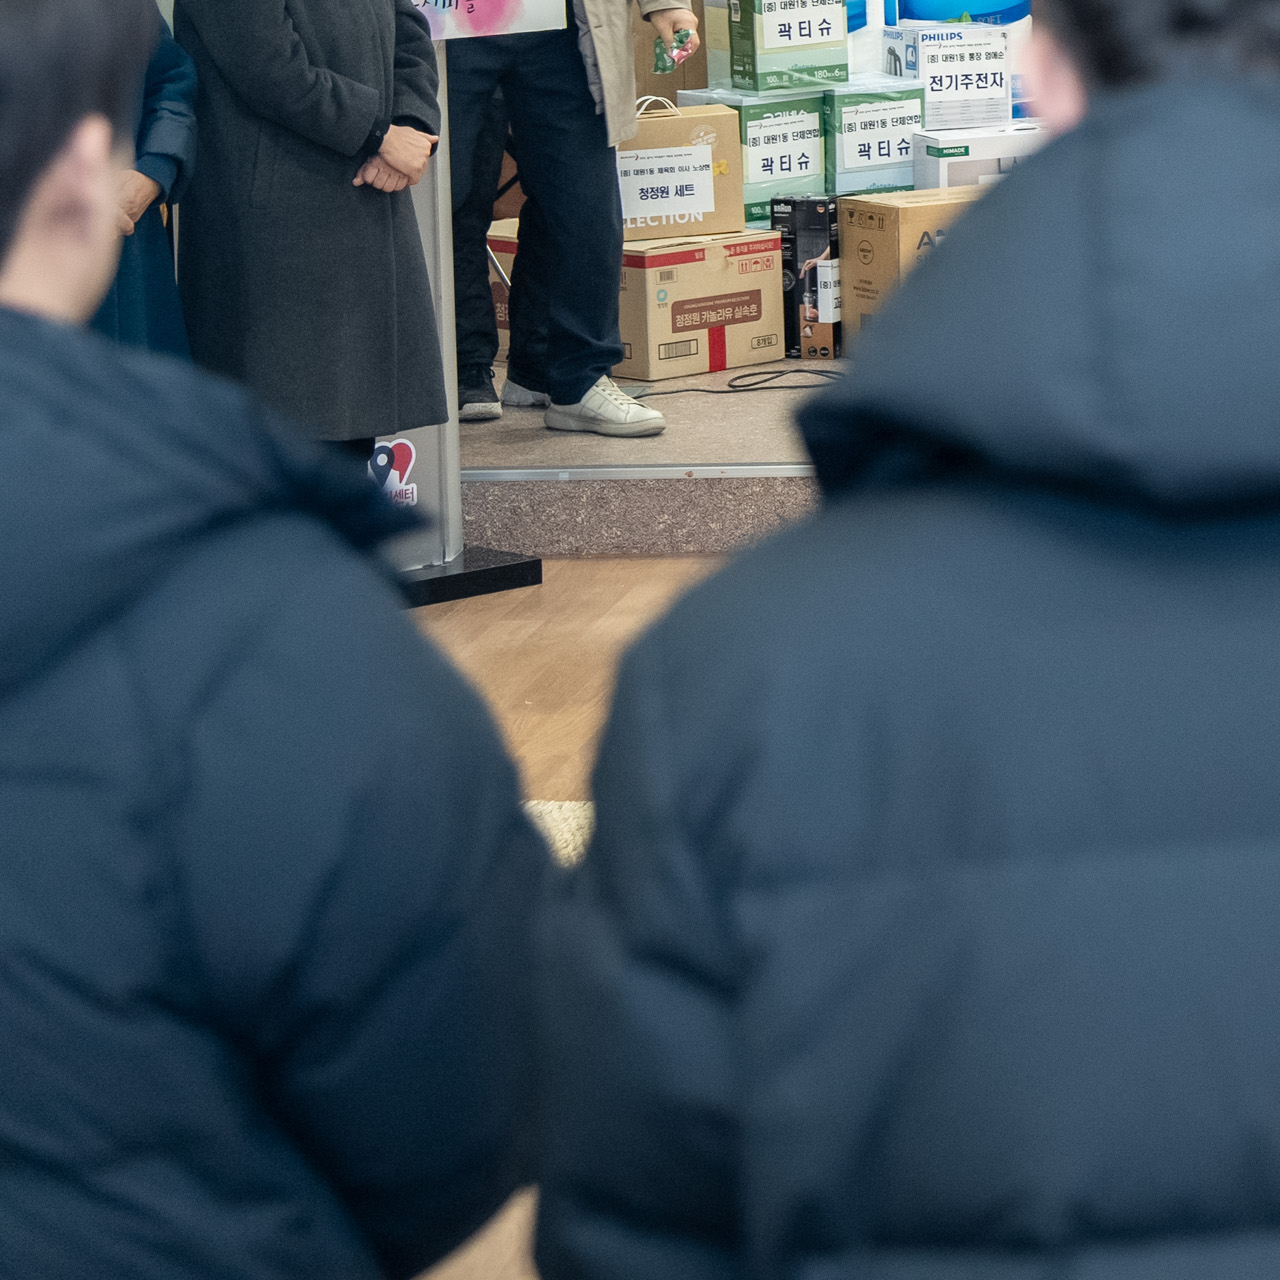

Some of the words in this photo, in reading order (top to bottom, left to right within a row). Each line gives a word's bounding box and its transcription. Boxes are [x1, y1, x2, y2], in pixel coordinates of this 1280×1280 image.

[780, 0, 807, 10] 대원1동
[921, 32, 963, 42] PHILIPS
[929, 71, 1004, 92] 전기주전자
[860, 119, 887, 131] 대원1동
[891, 114, 921, 127] 단체연합
[764, 133, 788, 145] 대원1동
[638, 185, 670, 201] 청정원
[674, 183, 695, 198] 세트
[676, 313, 700, 327] 청정원
[701, 308, 733, 323] 카놀라유
